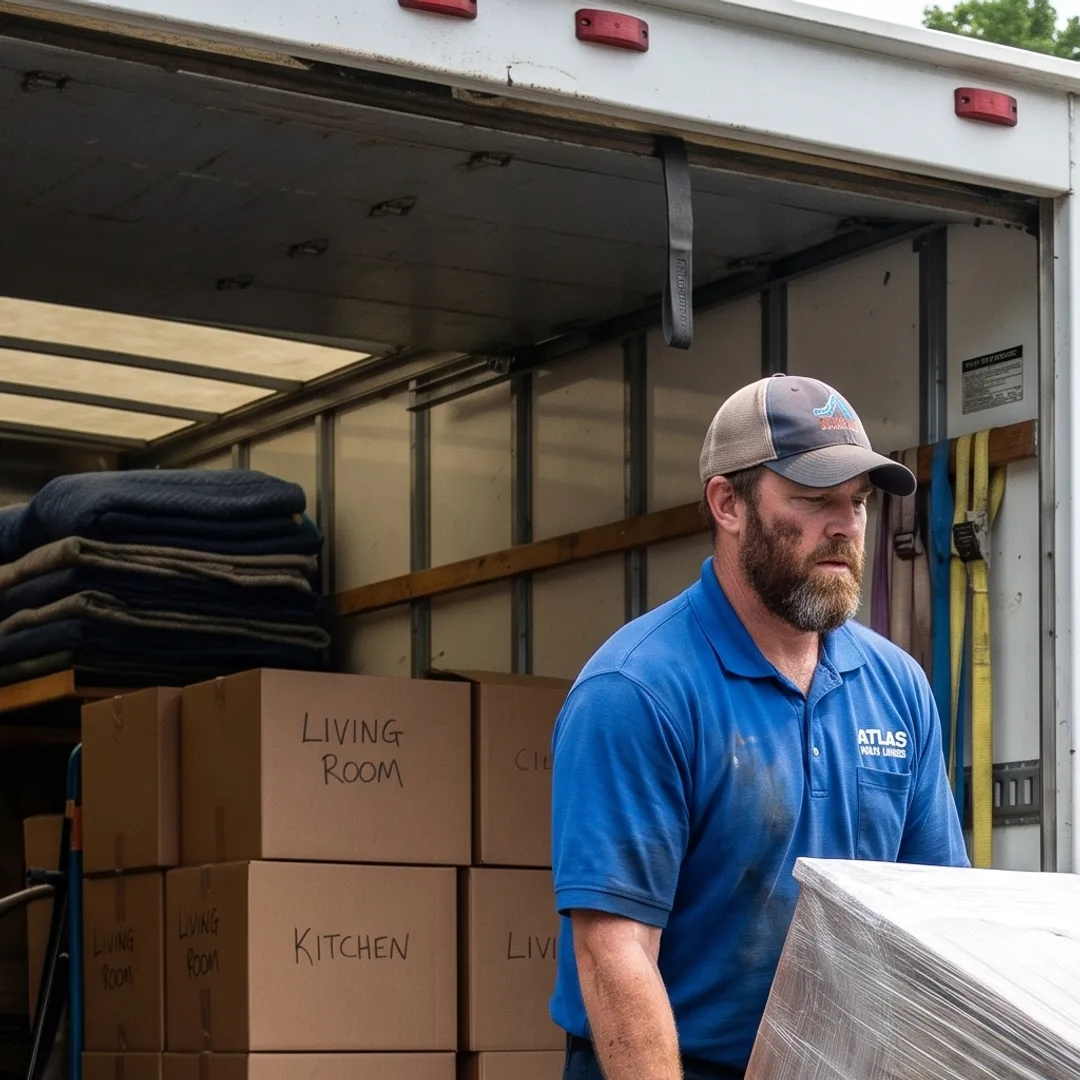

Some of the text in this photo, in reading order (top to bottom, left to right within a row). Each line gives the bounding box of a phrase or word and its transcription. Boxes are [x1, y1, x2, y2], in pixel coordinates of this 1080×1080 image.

[302, 711, 404, 748] LIVING
[857, 728, 908, 748] ATLAS
[321, 753, 404, 788] ROOM
[178, 907, 220, 940] LIVING
[93, 927, 135, 958] LIVING
[294, 926, 410, 967] KITCHEN
[507, 931, 557, 960] LIVI
[102, 963, 134, 991] ROOM
[186, 946, 220, 979] ROOM
